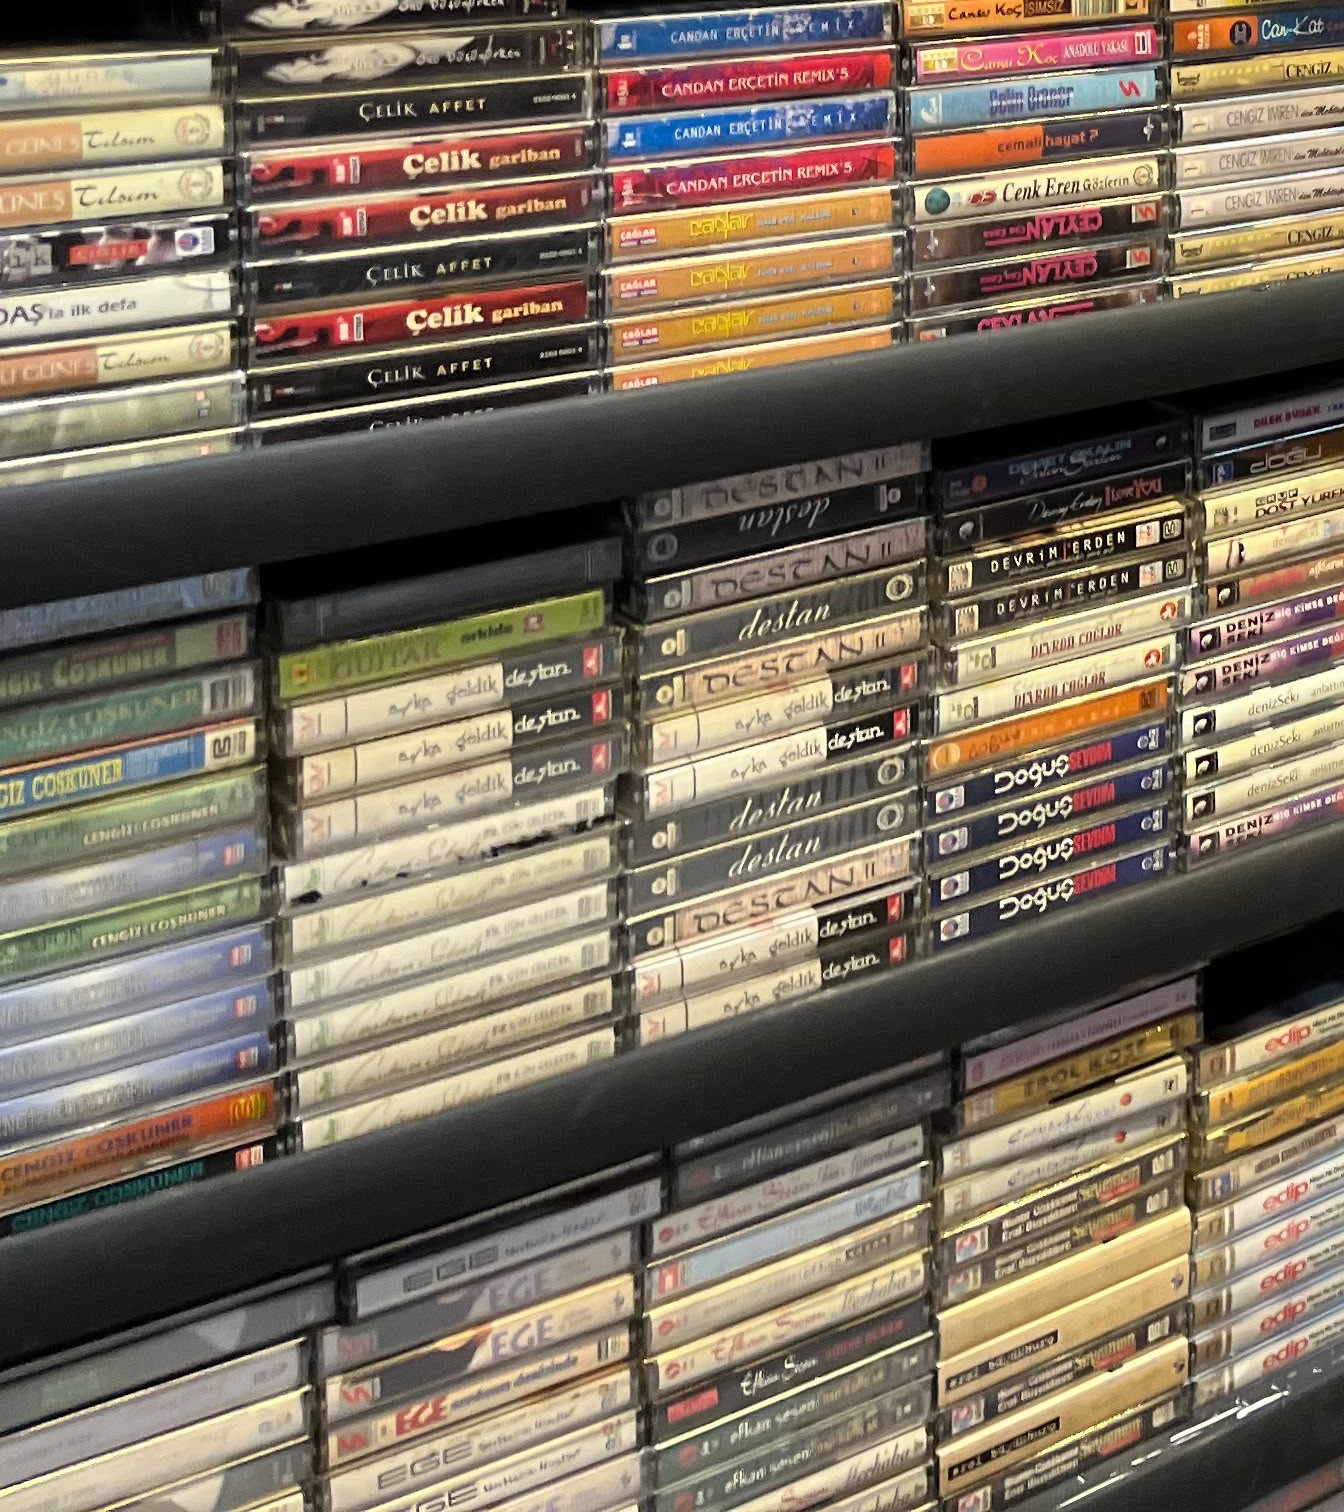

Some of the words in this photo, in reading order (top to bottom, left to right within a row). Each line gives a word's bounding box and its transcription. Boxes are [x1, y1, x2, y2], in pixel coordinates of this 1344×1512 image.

[661, 80, 727, 97] CANDAN
[359, 102, 417, 124] ÇELİK
[428, 97, 488, 115] AFFET
[402, 148, 483, 181] Çelik
[488, 146, 562, 171] gariban
[1002, 180, 1041, 204] Cenk
[1044, 177, 1080, 200] Eren
[408, 198, 488, 231] Çelik
[494, 195, 568, 220] gariban
[405, 303, 485, 336] Çelik
[490, 298, 564, 325] gariban
[1263, 1020, 1312, 1056] edip
[1262, 1178, 1310, 1213] edip
[1263, 1215, 1310, 1252] edip
